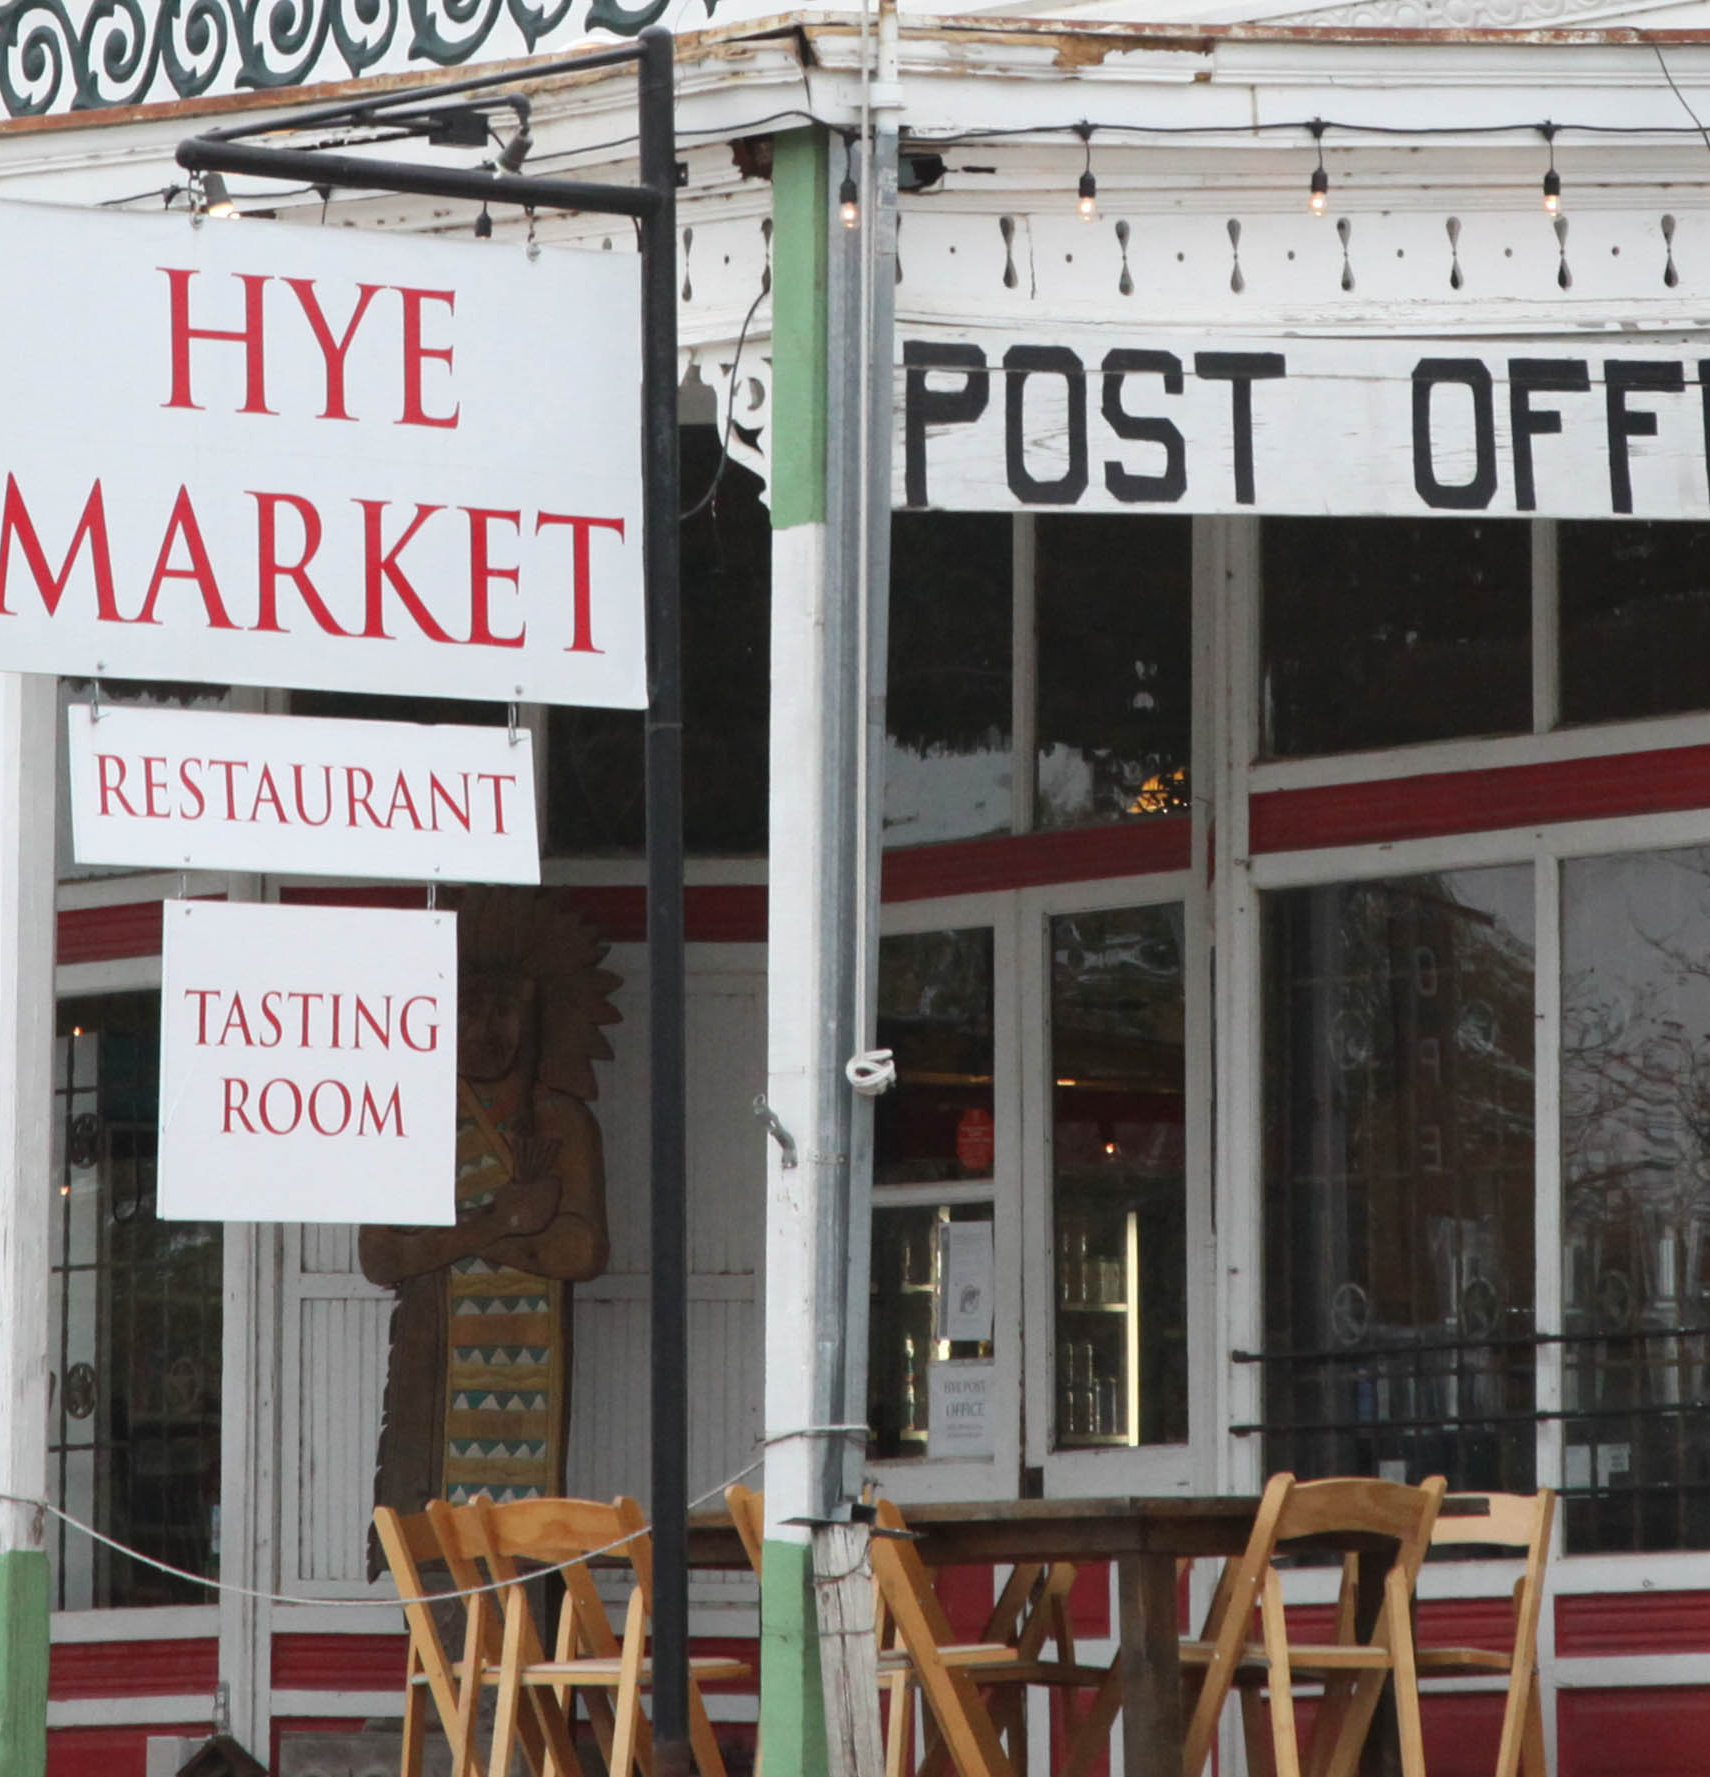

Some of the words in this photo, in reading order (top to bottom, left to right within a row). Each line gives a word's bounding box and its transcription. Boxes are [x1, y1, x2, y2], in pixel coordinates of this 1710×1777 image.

[156, 266, 460, 429] HYE
[902, 340, 1286, 507] POST
[93, 753, 517, 836] RESTAURANT
[185, 988, 439, 1053] TASTING
[220, 1077, 408, 1138] ROOM
